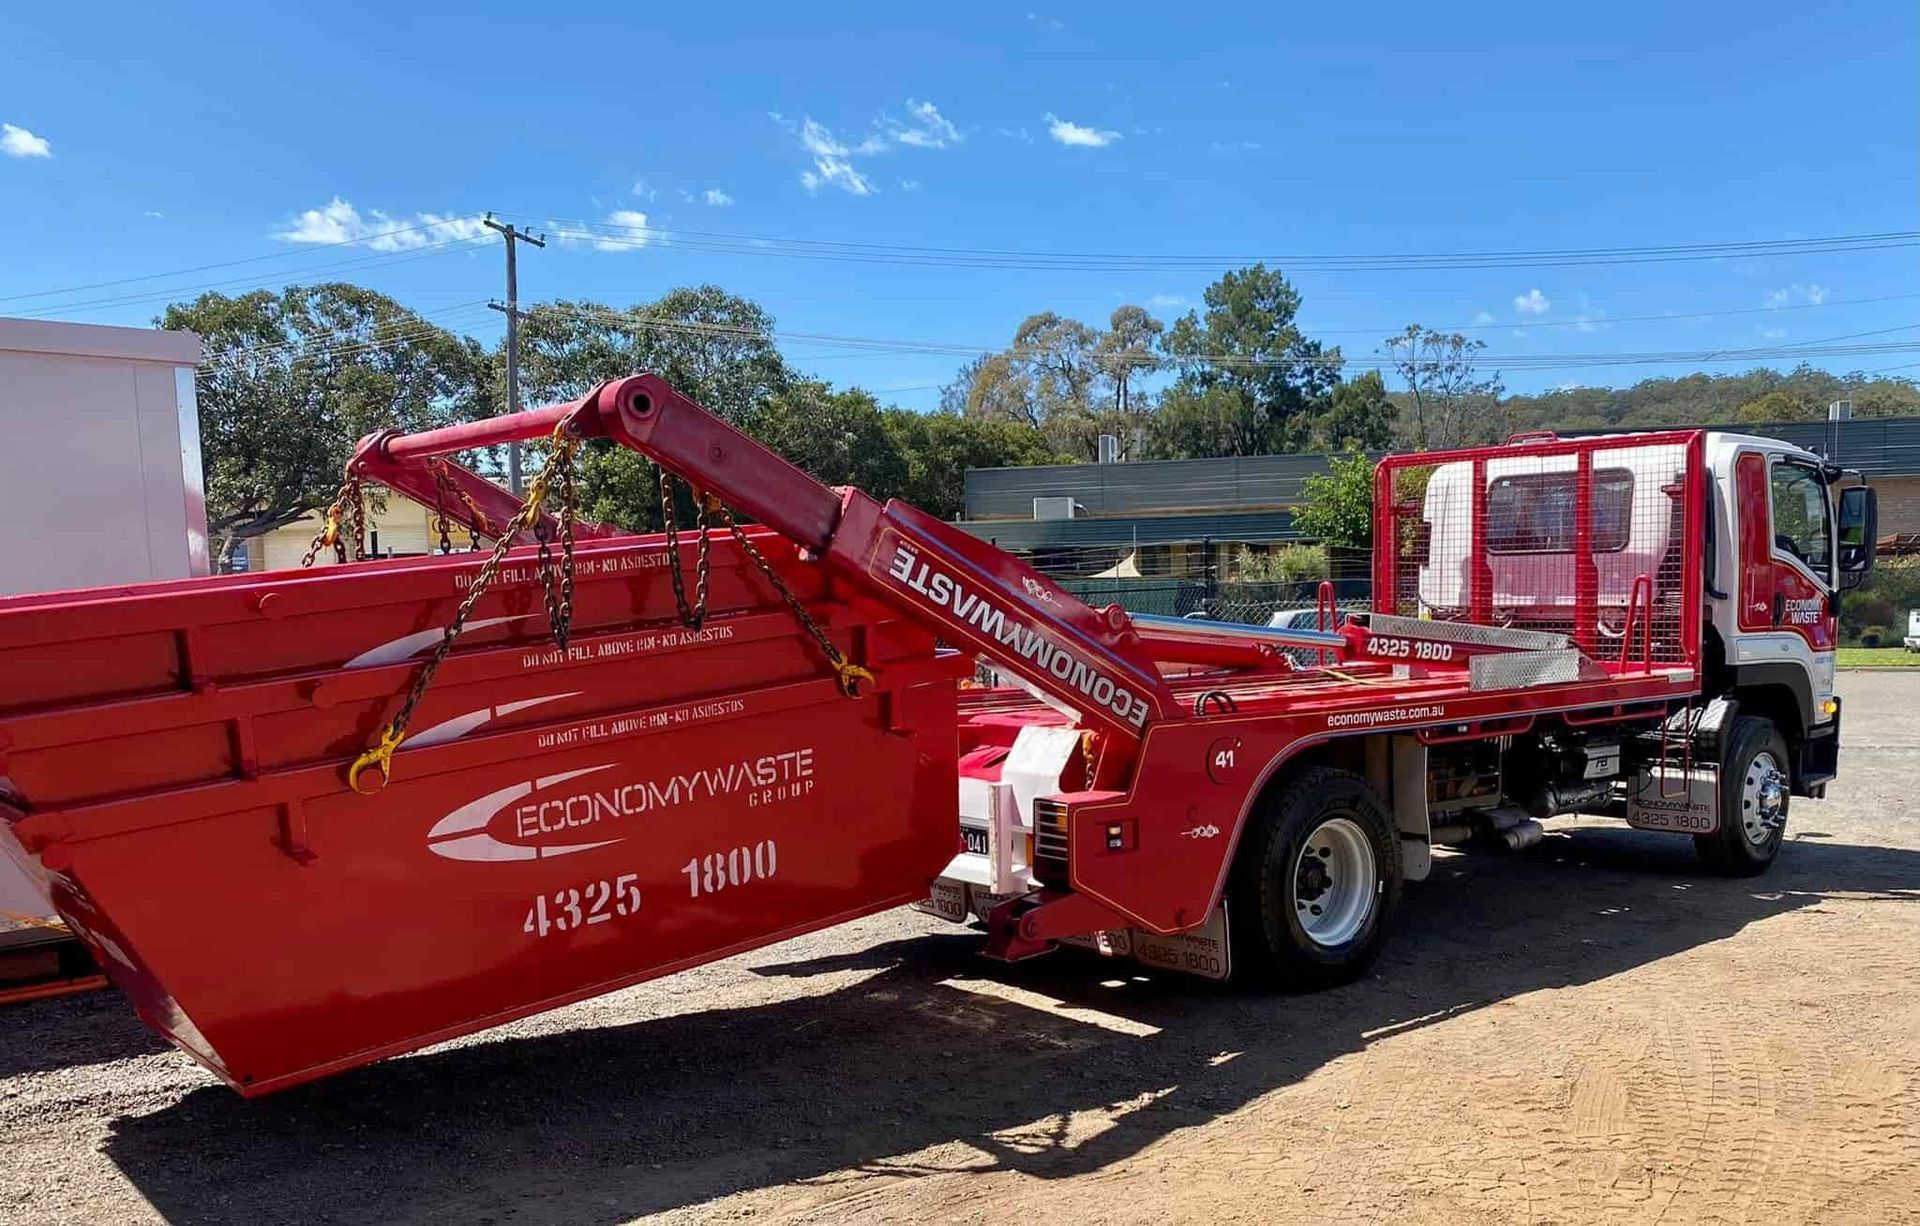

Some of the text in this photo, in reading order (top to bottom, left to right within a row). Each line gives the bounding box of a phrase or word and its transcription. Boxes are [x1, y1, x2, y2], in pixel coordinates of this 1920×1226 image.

[502, 568, 531, 584] FILL
[1784, 599, 1824, 612] ECONOMY
[1791, 611, 1819, 624] WASTE
[523, 653, 540, 668] DO
[542, 650, 564, 666] NOT
[568, 645, 594, 661] FILL
[598, 639, 635, 657] ABOVE
[679, 625, 734, 646] ASBESTOS
[889, 546, 1150, 729] ECONOMYWASTE
[1367, 636, 1453, 662] 4325 1800
[538, 733, 554, 748] DO
[557, 728, 579, 745] NOT
[582, 724, 609, 740] FILL
[611, 715, 647, 736] ABOVE
[692, 698, 745, 721] ASBESTOS
[1327, 704, 1445, 728] economywaste.com.au
[1215, 750, 1235, 769] 41
[516, 748, 814, 838] ECONOMYWASTE
[749, 780, 815, 808] GROUP
[1632, 811, 1711, 830] 4325 1800
[966, 832, 988, 855] 041
[523, 840, 778, 937] 4325 1800
[1139, 943, 1178, 964] 4325
[1183, 951, 1219, 974] 1800
